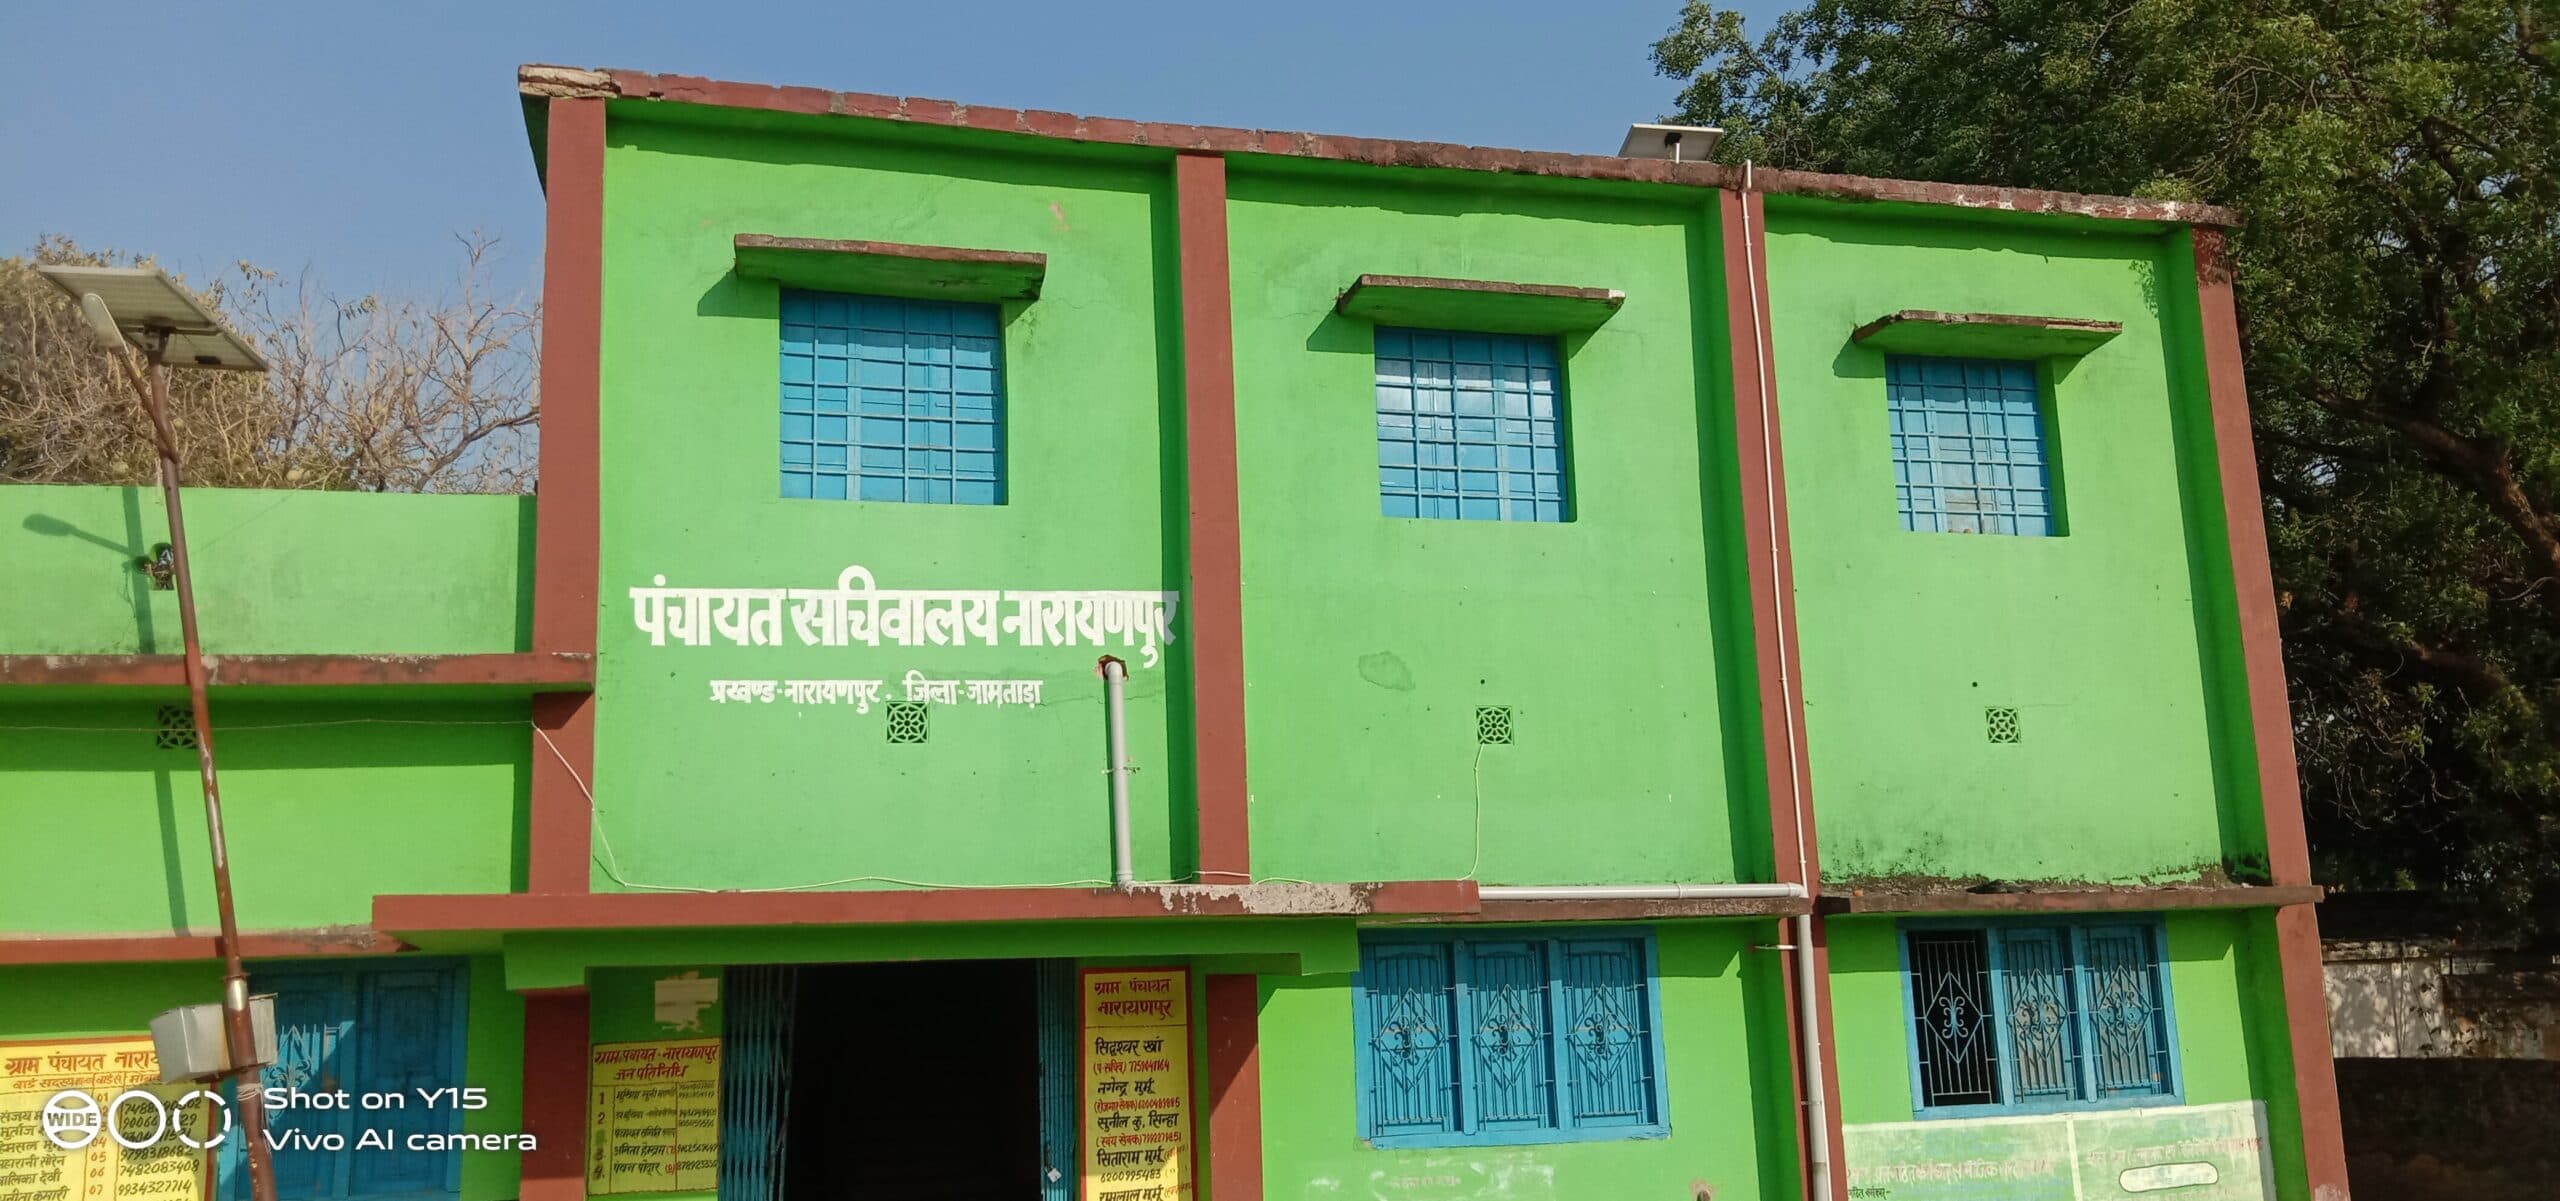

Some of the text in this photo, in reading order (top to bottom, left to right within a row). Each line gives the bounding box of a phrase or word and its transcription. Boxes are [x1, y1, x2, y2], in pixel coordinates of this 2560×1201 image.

[629, 565, 1180, 668] पंचायत सचिवालय नारायणपुर
[1129, 977, 1171, 992] पंचायत
[1098, 999, 1174, 1020] नारायणपुर
[5, 1056, 42, 1075] ग्राम
[48, 1051, 106, 1072] पंचायत
[1097, 1112, 1130, 1132] सुनील
[90, 1152, 107, 1163] 05
[90, 1167, 105, 1178] 06
[88, 1184, 103, 1196] 07
